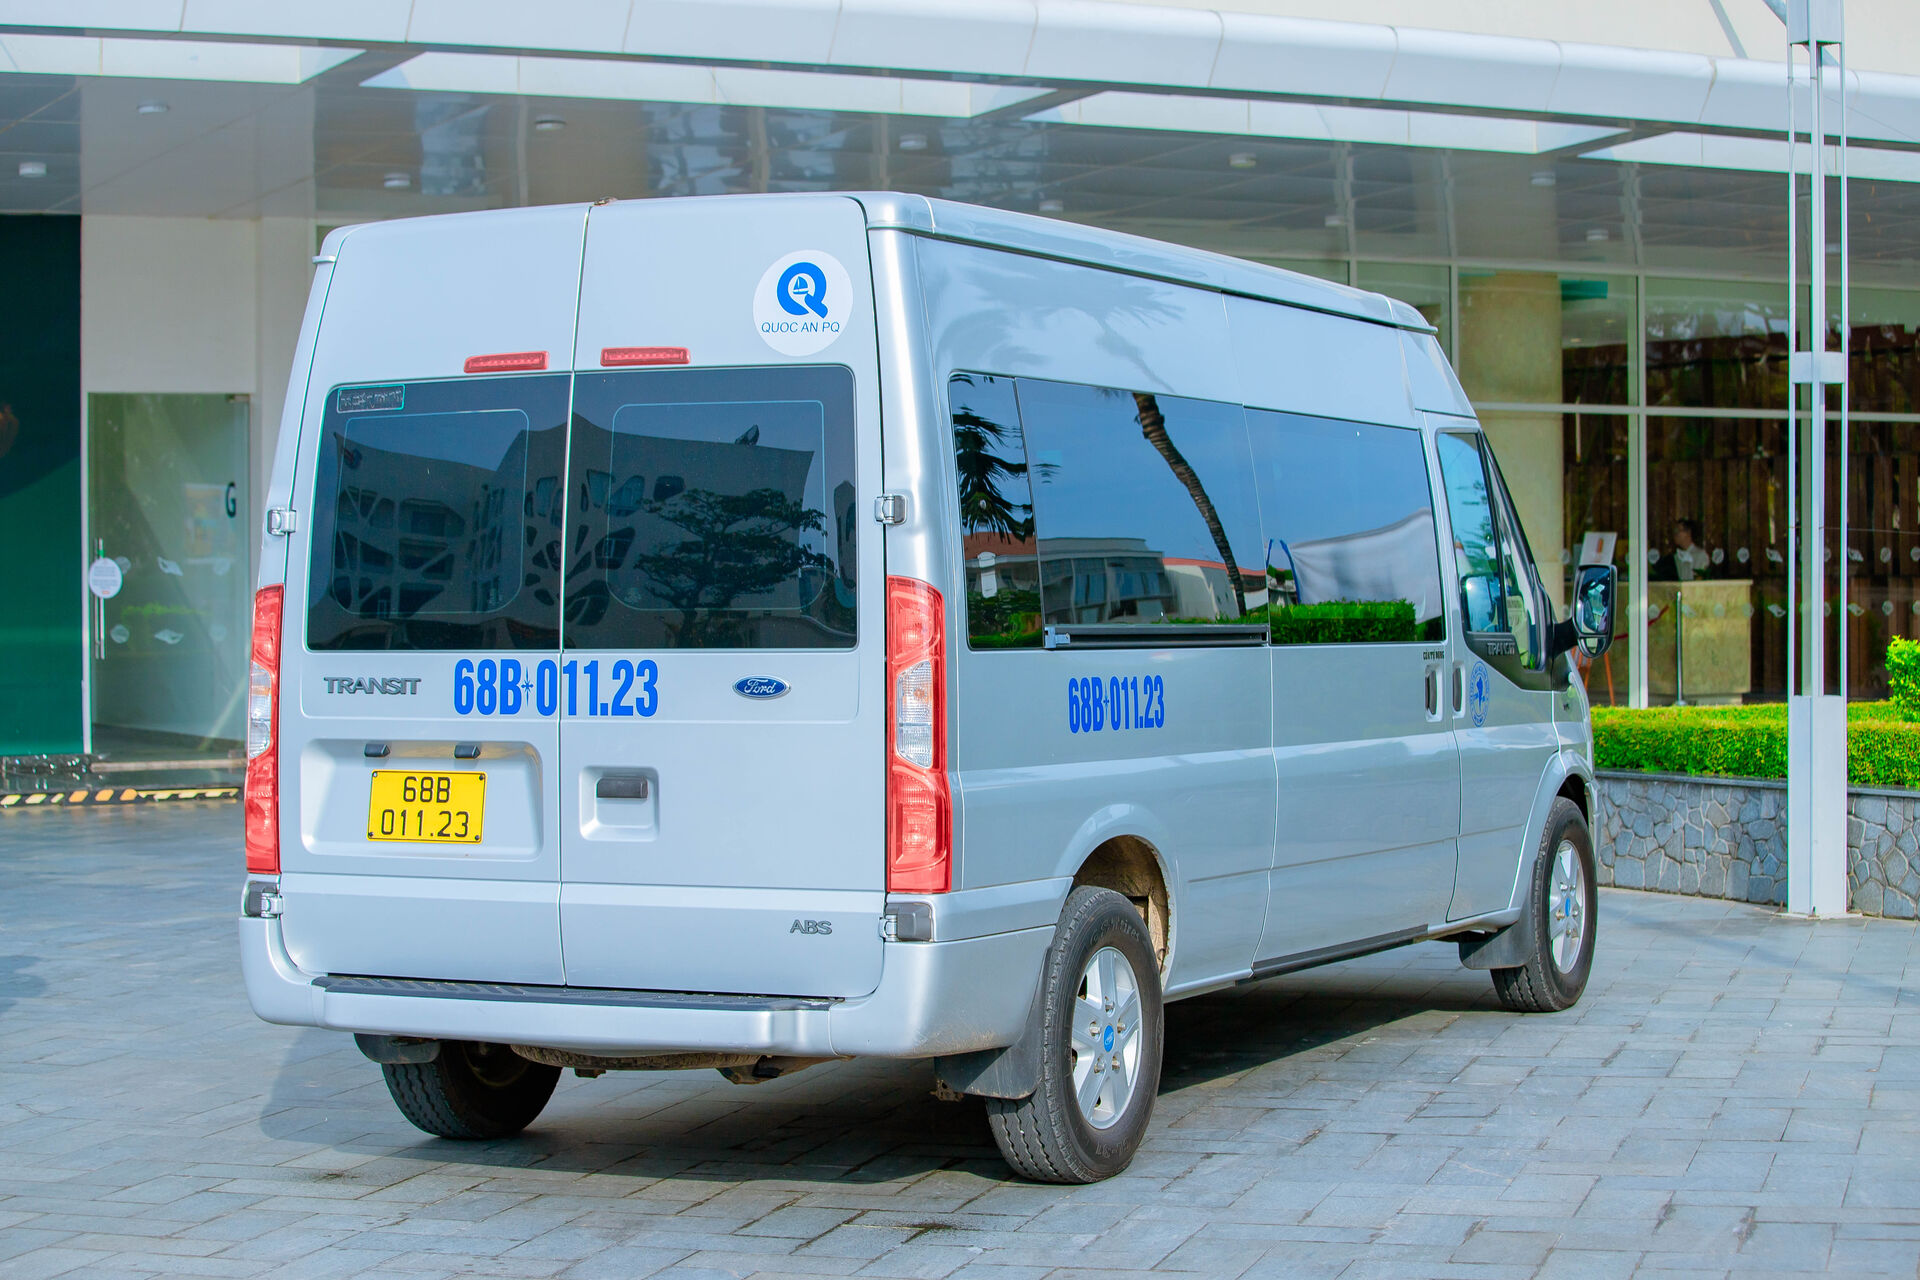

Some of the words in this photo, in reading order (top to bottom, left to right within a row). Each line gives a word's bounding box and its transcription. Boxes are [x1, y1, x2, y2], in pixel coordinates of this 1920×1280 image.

[761, 321, 798, 333] QUOC
[801, 322, 819, 333] AN
[822, 322, 840, 333] PQ
[225, 482, 237, 518] G
[323, 677, 422, 695] TRANSIT
[744, 678, 776, 694] Ford
[403, 776, 451, 803] 68B
[381, 809, 470, 838] 011.23
[790, 919, 832, 935] ABS
